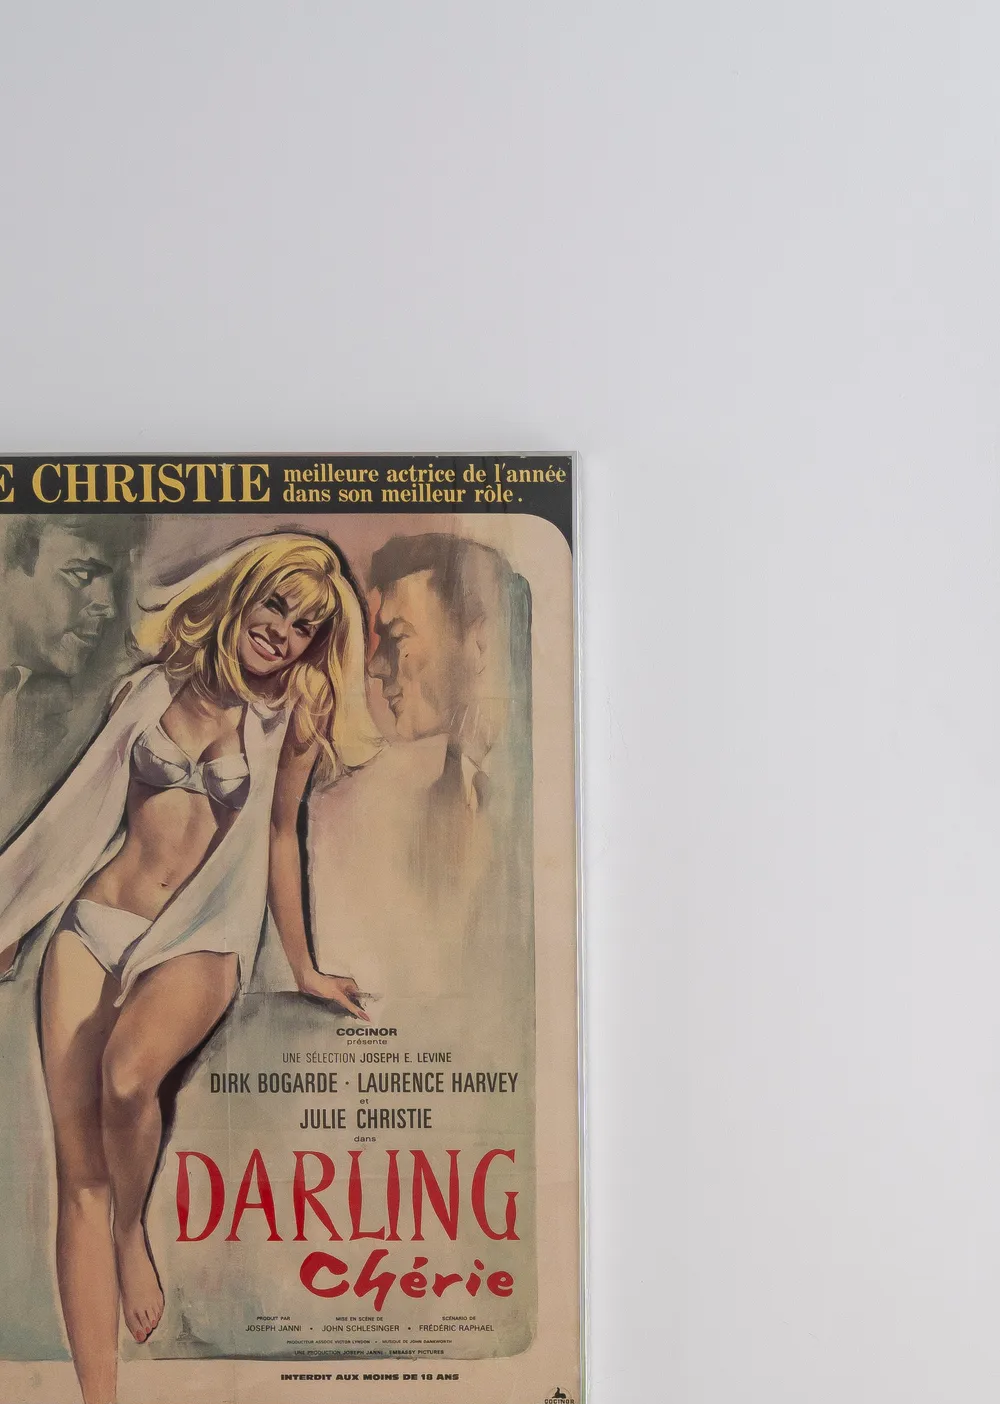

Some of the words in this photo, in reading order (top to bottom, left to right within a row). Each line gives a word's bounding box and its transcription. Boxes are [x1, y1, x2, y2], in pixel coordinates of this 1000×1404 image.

[32, 463, 271, 503] CHRISTIE
[284, 463, 379, 482] meilleure
[386, 463, 456, 482] actrice
[462, 463, 488, 482] de
[495, 463, 567, 483] l'année
[283, 483, 331, 502] dans
[338, 487, 373, 502] son
[381, 483, 466, 502] meilleur
[336, 1027, 398, 1037] COCINOR
[347, 1037, 388, 1046] présente
[282, 1052, 303, 1063] UNE
[306, 1051, 356, 1063] SÉLECTION
[359, 1052, 400, 1063] JOSEPH
[404, 1052, 412, 1063] E.
[417, 1052, 452, 1063] LEVINE
[210, 1072, 251, 1093] DIRK
[257, 1072, 338, 1093] BOGARDE
[358, 1072, 444, 1093] LAURENCE
[452, 1072, 518, 1093] HARVEY
[299, 1108, 346, 1129] JULIE
[356, 1108, 432, 1129] CHRISTIE
[175, 1148, 521, 1242] DARLING
[299, 1248, 514, 1312] Chérie
